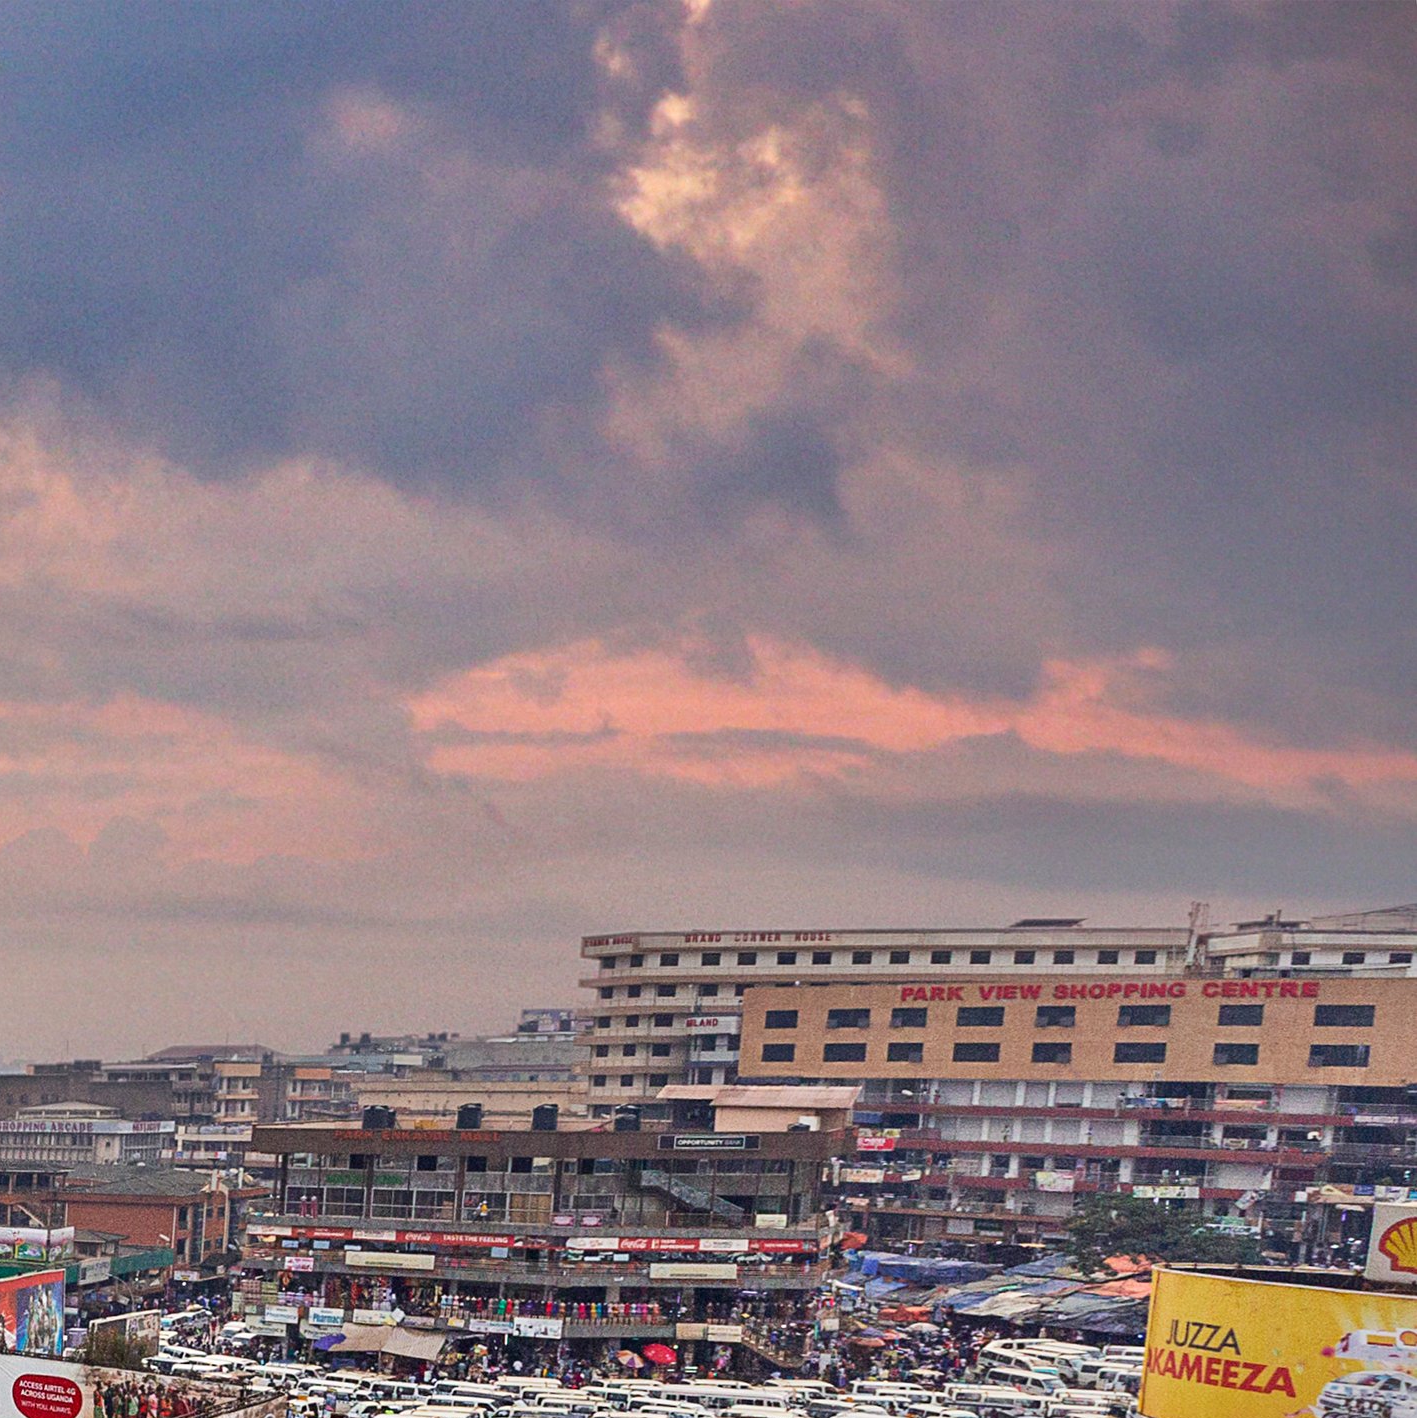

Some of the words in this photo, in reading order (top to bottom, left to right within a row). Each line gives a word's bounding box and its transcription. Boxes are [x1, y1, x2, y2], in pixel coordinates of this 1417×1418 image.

[901, 985, 964, 1003] PARK
[979, 983, 1042, 1000] VIEW
[1054, 981, 1186, 1000] SHOPPING
[1202, 979, 1320, 999] CENTRE
[51, 1121, 93, 1132] ARCADE
[677, 1138, 723, 1146] OPPORTUNITY
[478, 1235, 508, 1243] FEELING
[620, 1239, 647, 1249] Coca-Cola
[1166, 1319, 1240, 1355] JUZZA
[19, 1380, 43, 1391] ACCESS
[43, 1382, 65, 1393] AIRTEL
[20, 1389, 46, 1400] ACROSS
[46, 1392, 74, 1404] UGANDA
